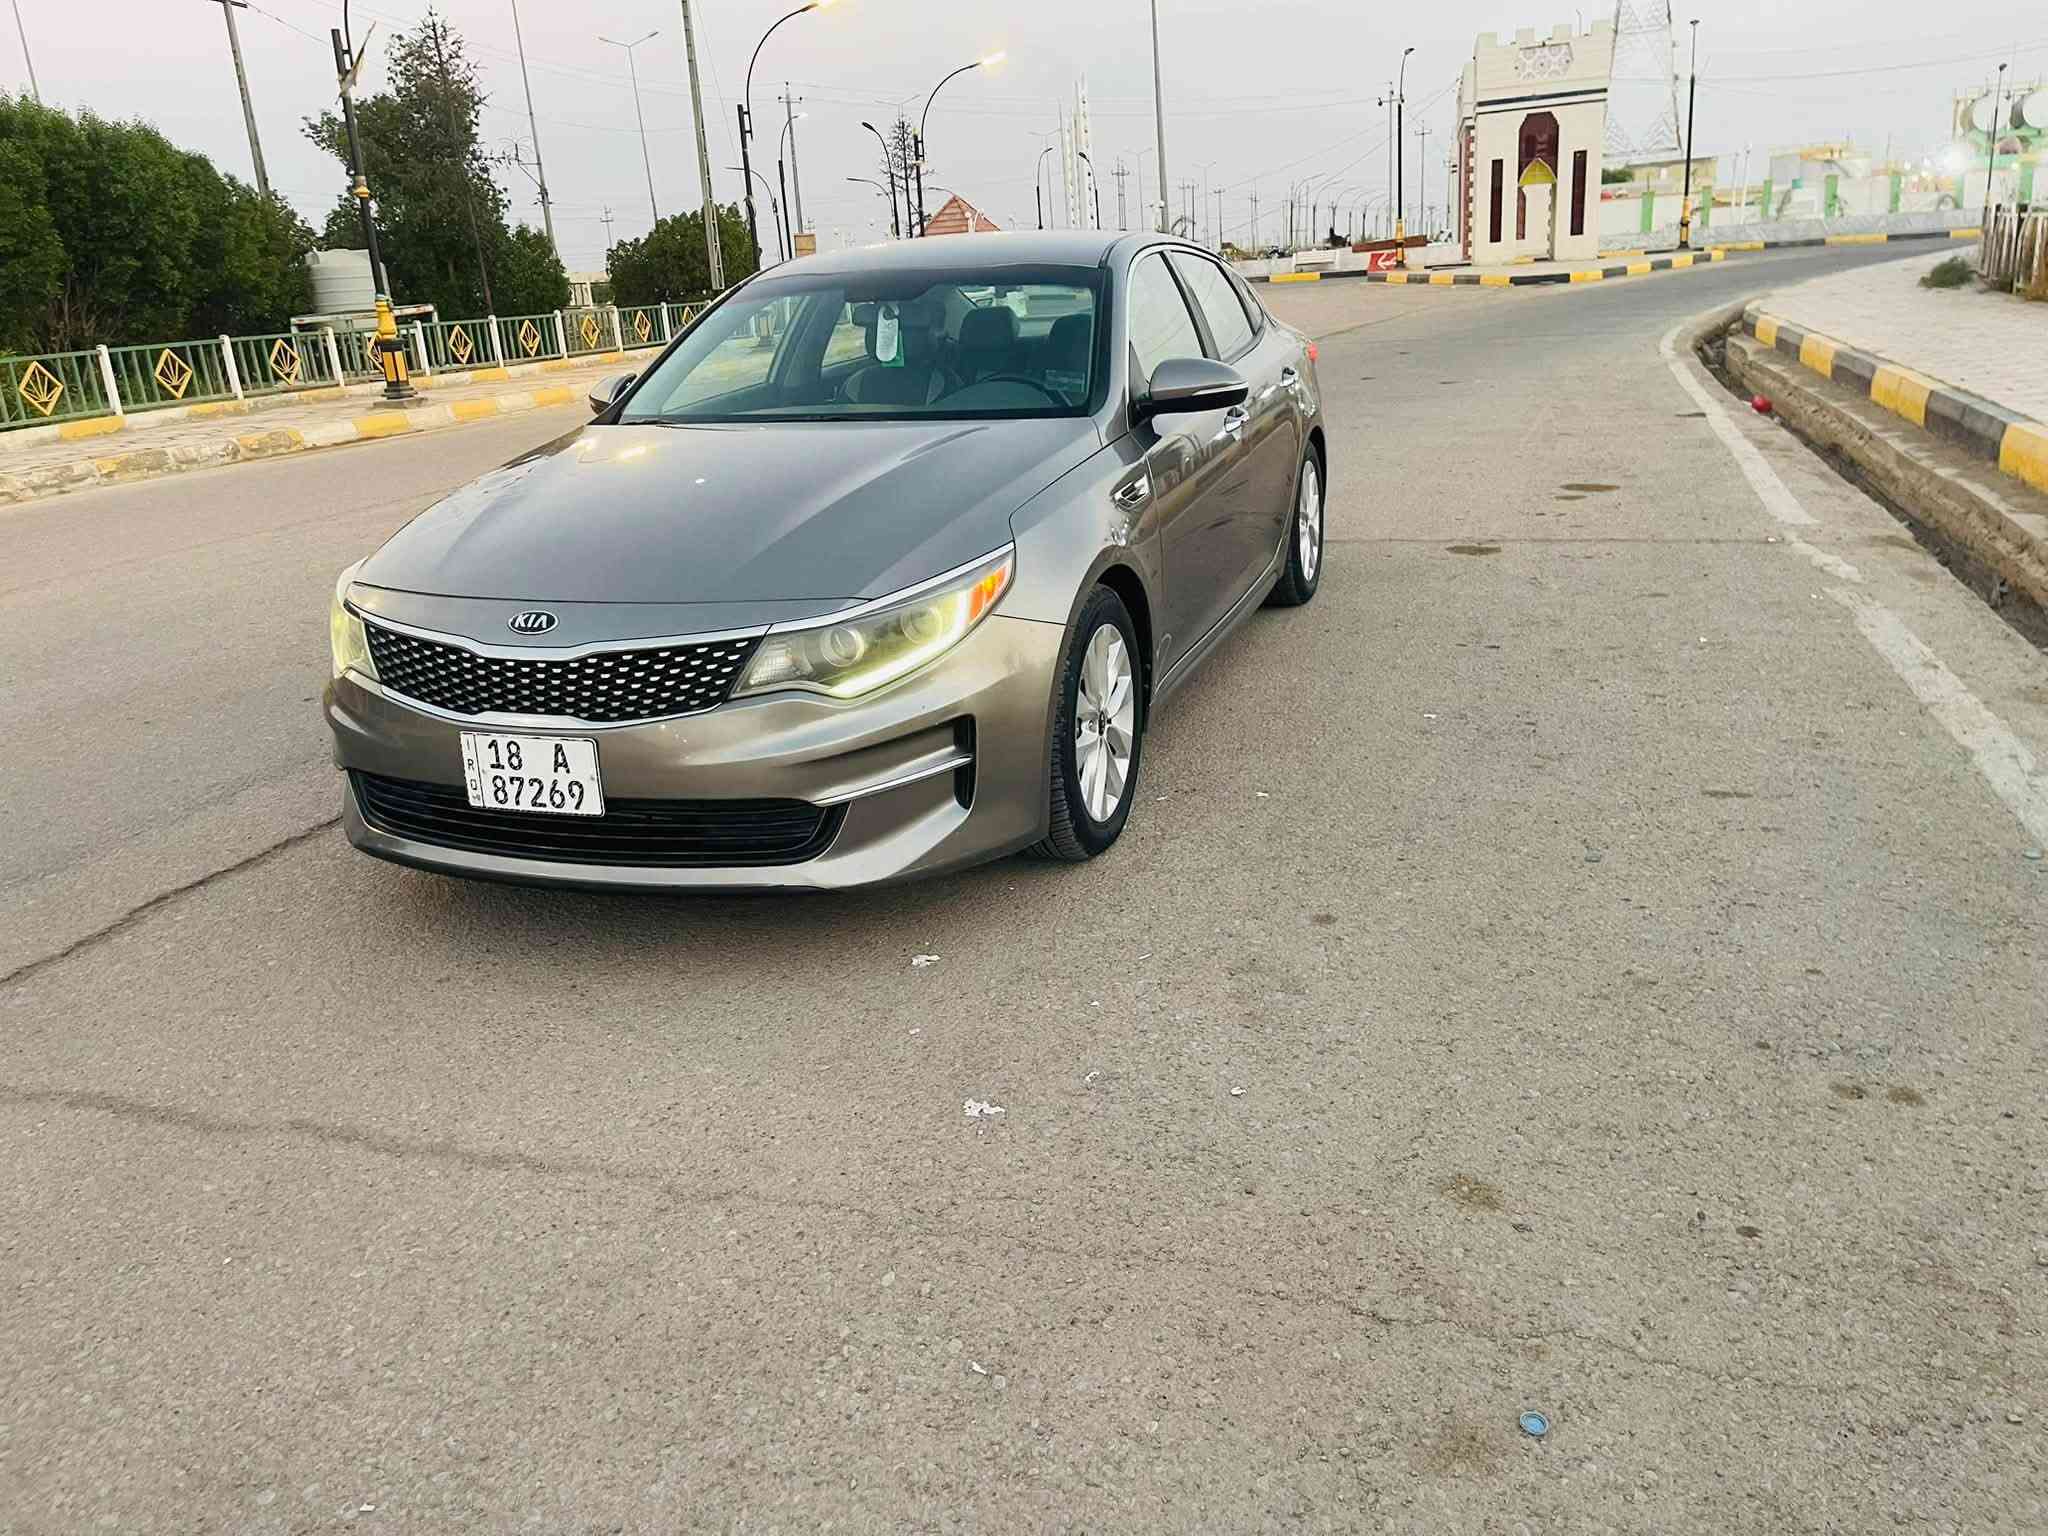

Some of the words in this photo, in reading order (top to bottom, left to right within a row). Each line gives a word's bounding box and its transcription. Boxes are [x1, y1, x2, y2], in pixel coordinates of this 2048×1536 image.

[514, 613, 547, 628] KIA
[487, 738, 523, 771] 18
[553, 743, 571, 774] A
[491, 774, 586, 811] 87269
